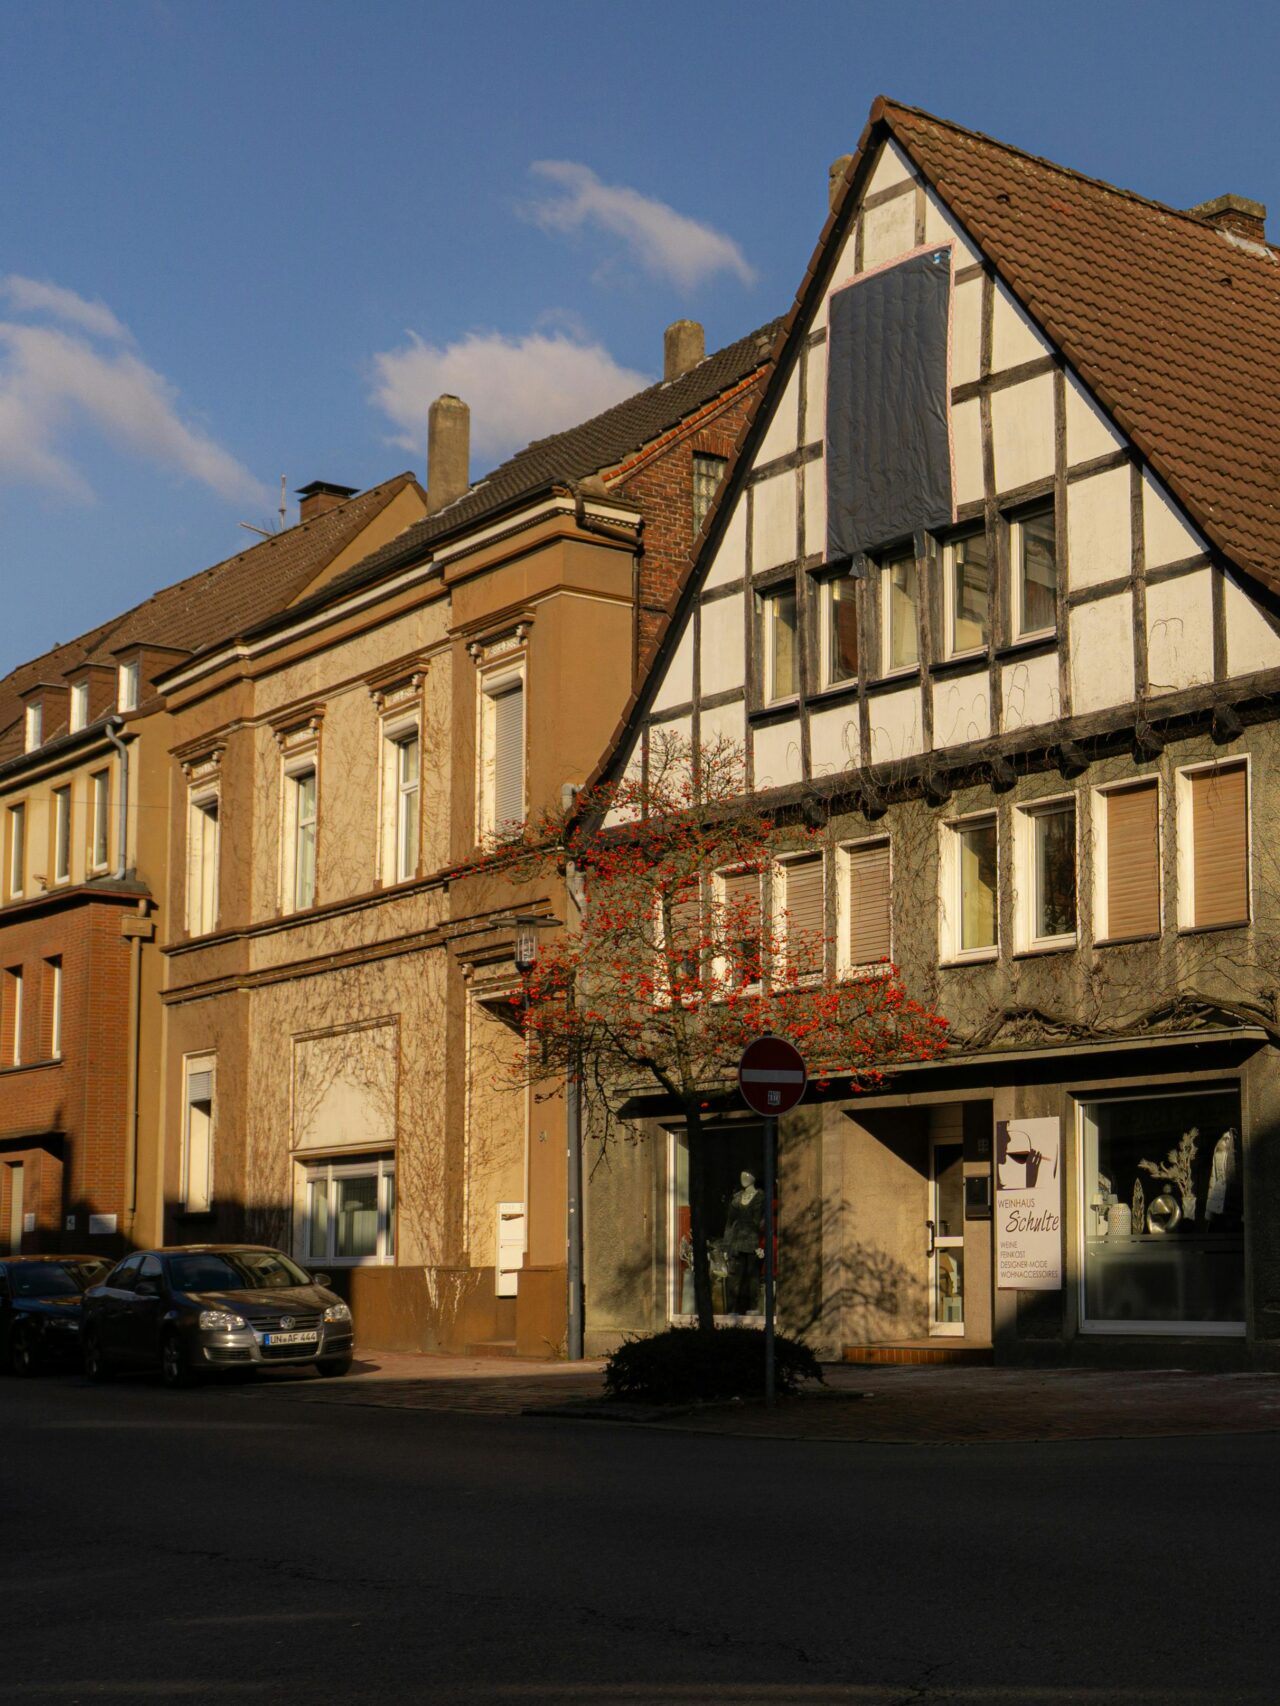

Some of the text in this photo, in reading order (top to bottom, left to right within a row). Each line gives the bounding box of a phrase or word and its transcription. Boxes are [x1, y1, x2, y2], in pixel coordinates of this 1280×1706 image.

[997, 1198, 1036, 1208] WEINHAUS
[1005, 1209, 1060, 1233] Schulte
[1000, 1240, 1018, 1249] WEINE
[1000, 1250, 1026, 1259] FEINKOST
[1000, 1270, 1059, 1279] WOHNACCESSOIRES
